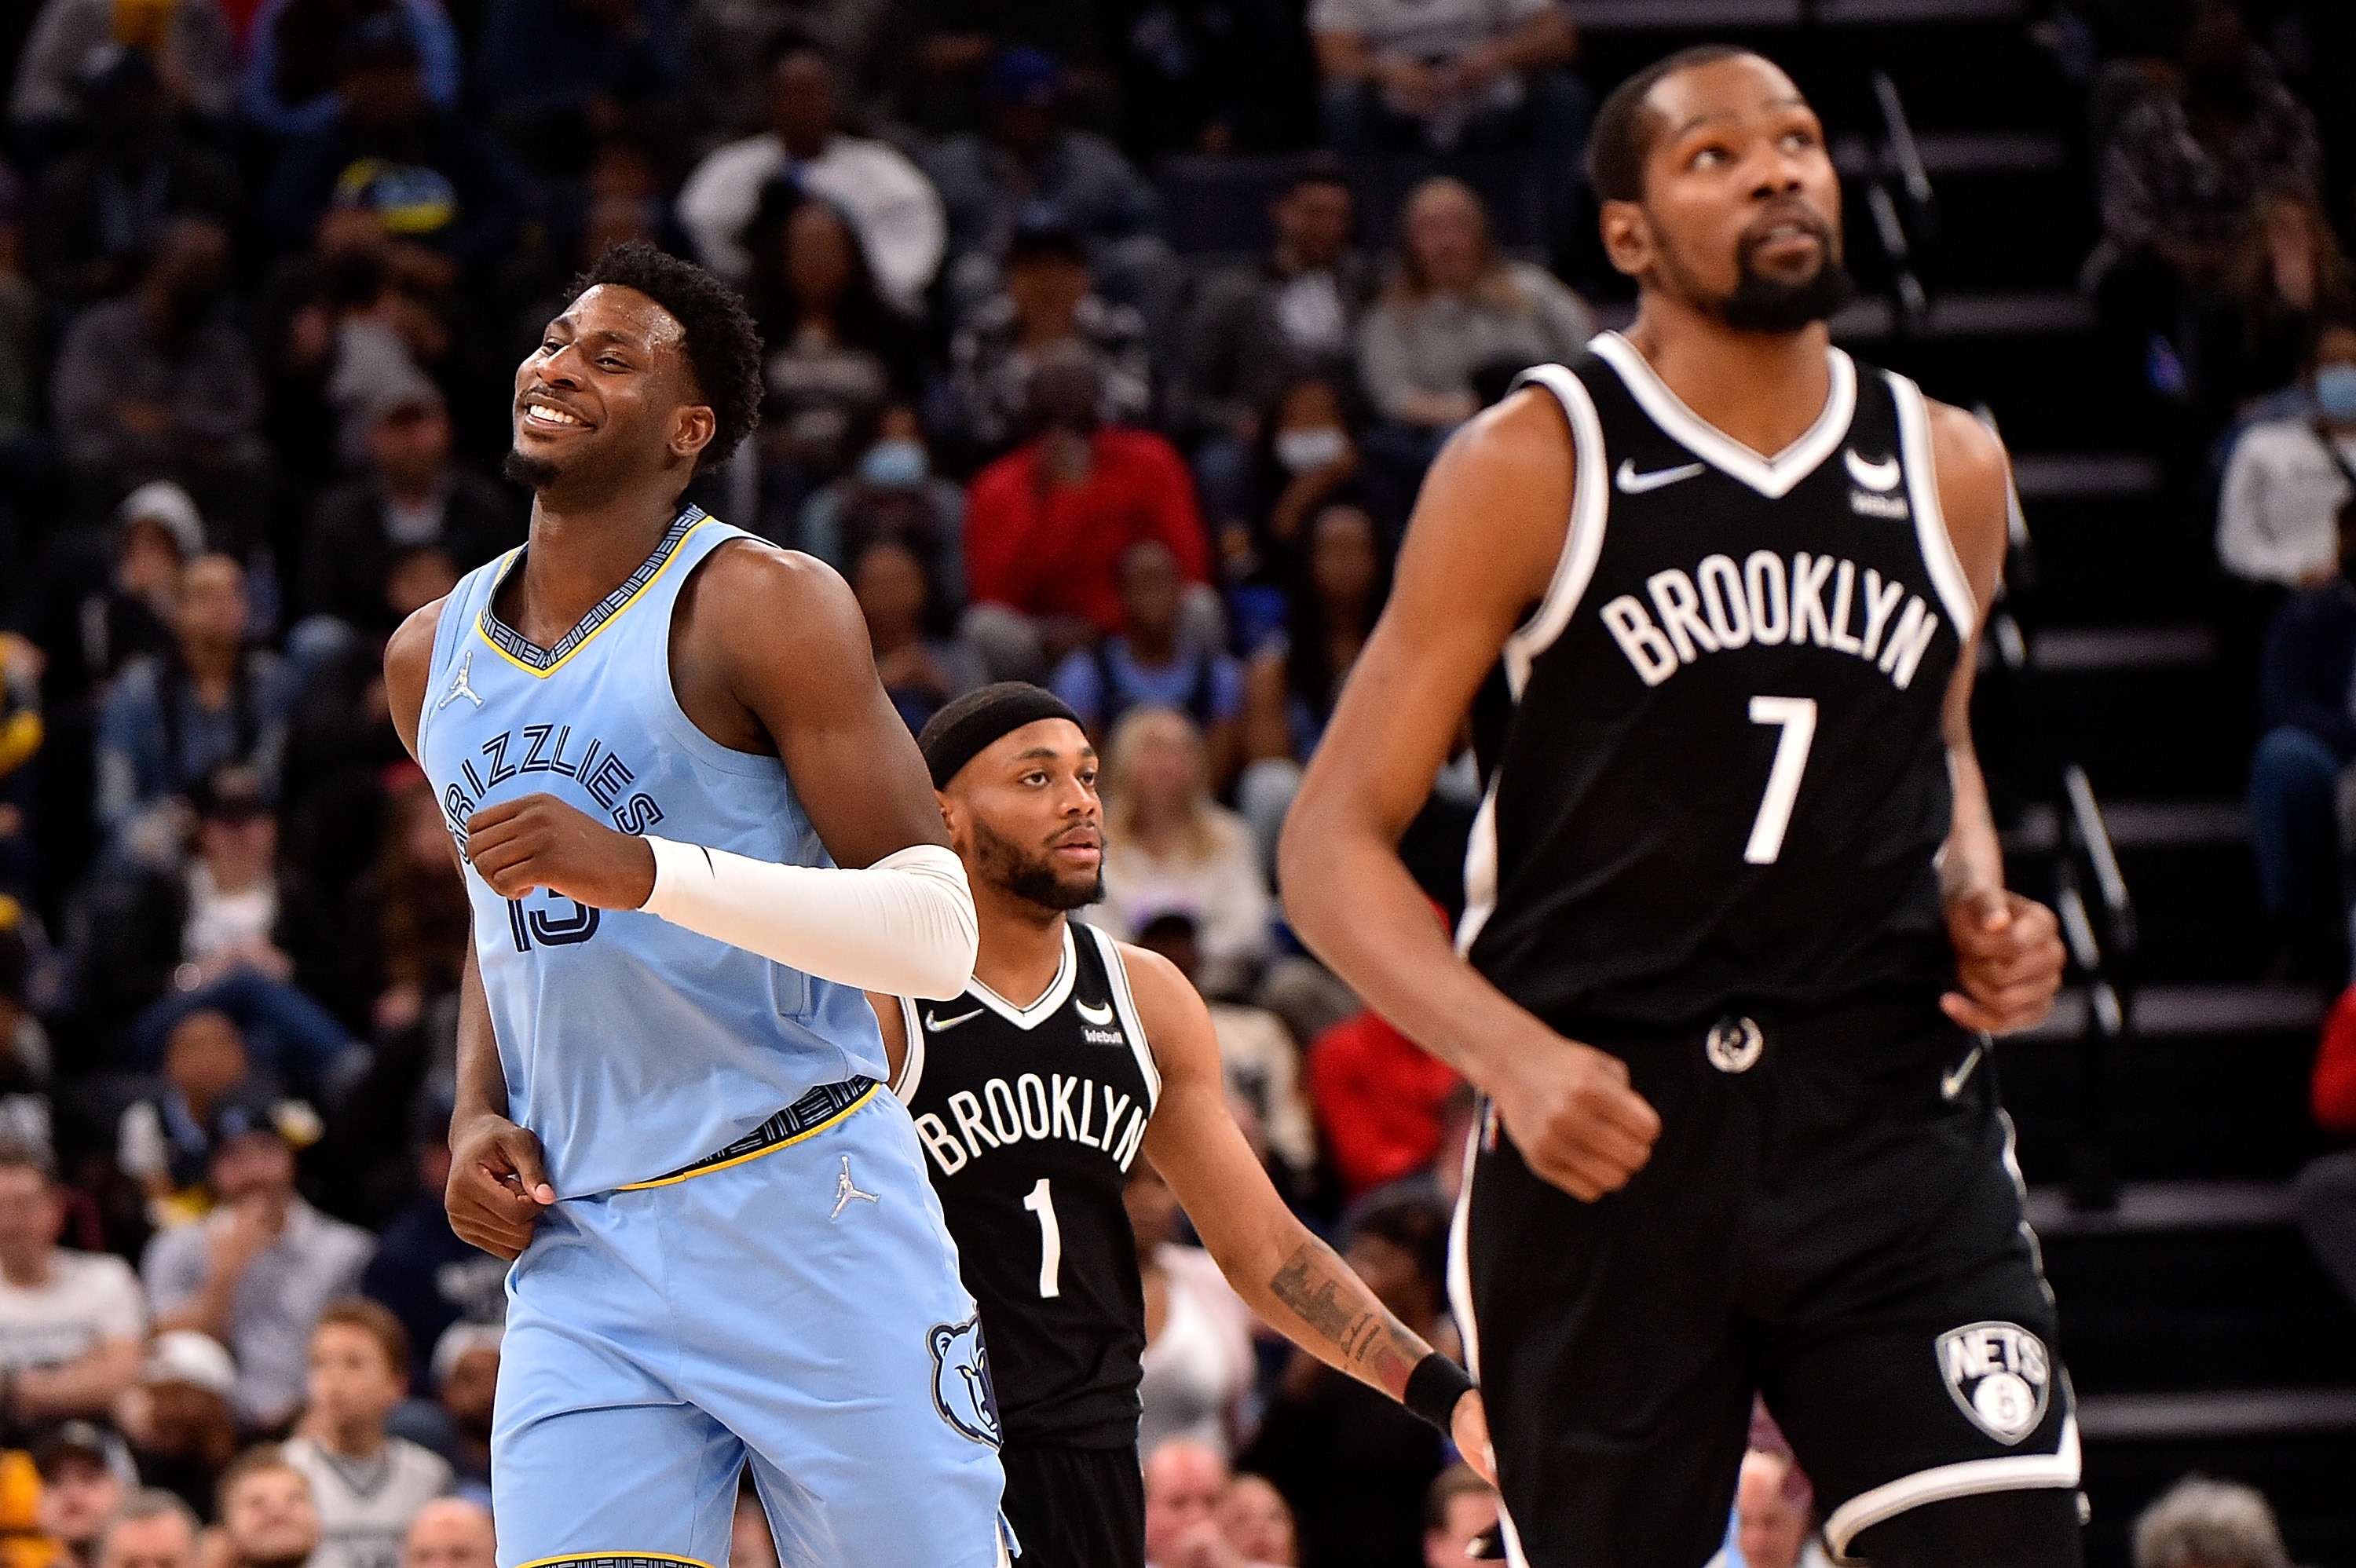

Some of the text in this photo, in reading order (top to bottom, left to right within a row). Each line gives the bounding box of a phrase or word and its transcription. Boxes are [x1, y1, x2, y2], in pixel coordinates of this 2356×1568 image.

[1600, 550, 1939, 691] BROOKLYN
[1743, 695, 1818, 864] 7
[1085, 1029, 1124, 1044] Webull
[914, 1073, 1148, 1177] BROOKLYN
[1023, 1178, 1061, 1299] 1
[1945, 1327, 2047, 1387] NETS
